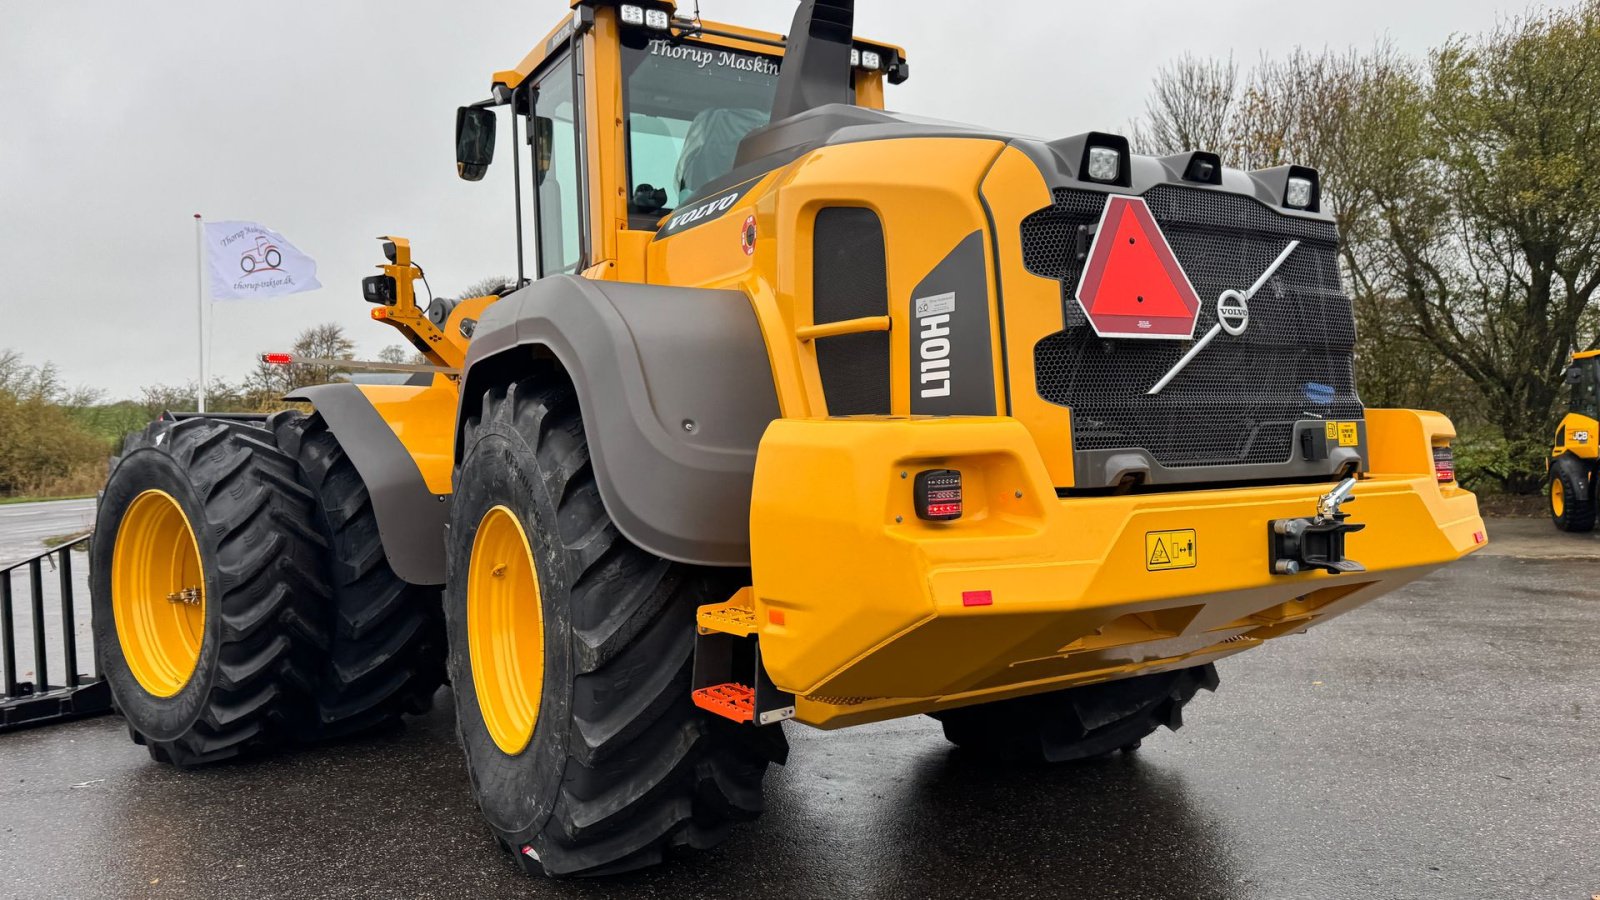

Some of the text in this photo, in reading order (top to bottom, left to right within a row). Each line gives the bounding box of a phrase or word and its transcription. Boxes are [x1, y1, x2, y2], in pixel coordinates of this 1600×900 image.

[649, 38, 779, 75] Thorup Maskin
[667, 192, 739, 231] VOLVO
[1219, 308, 1248, 316] VOLVO
[920, 313, 951, 398] L110H
